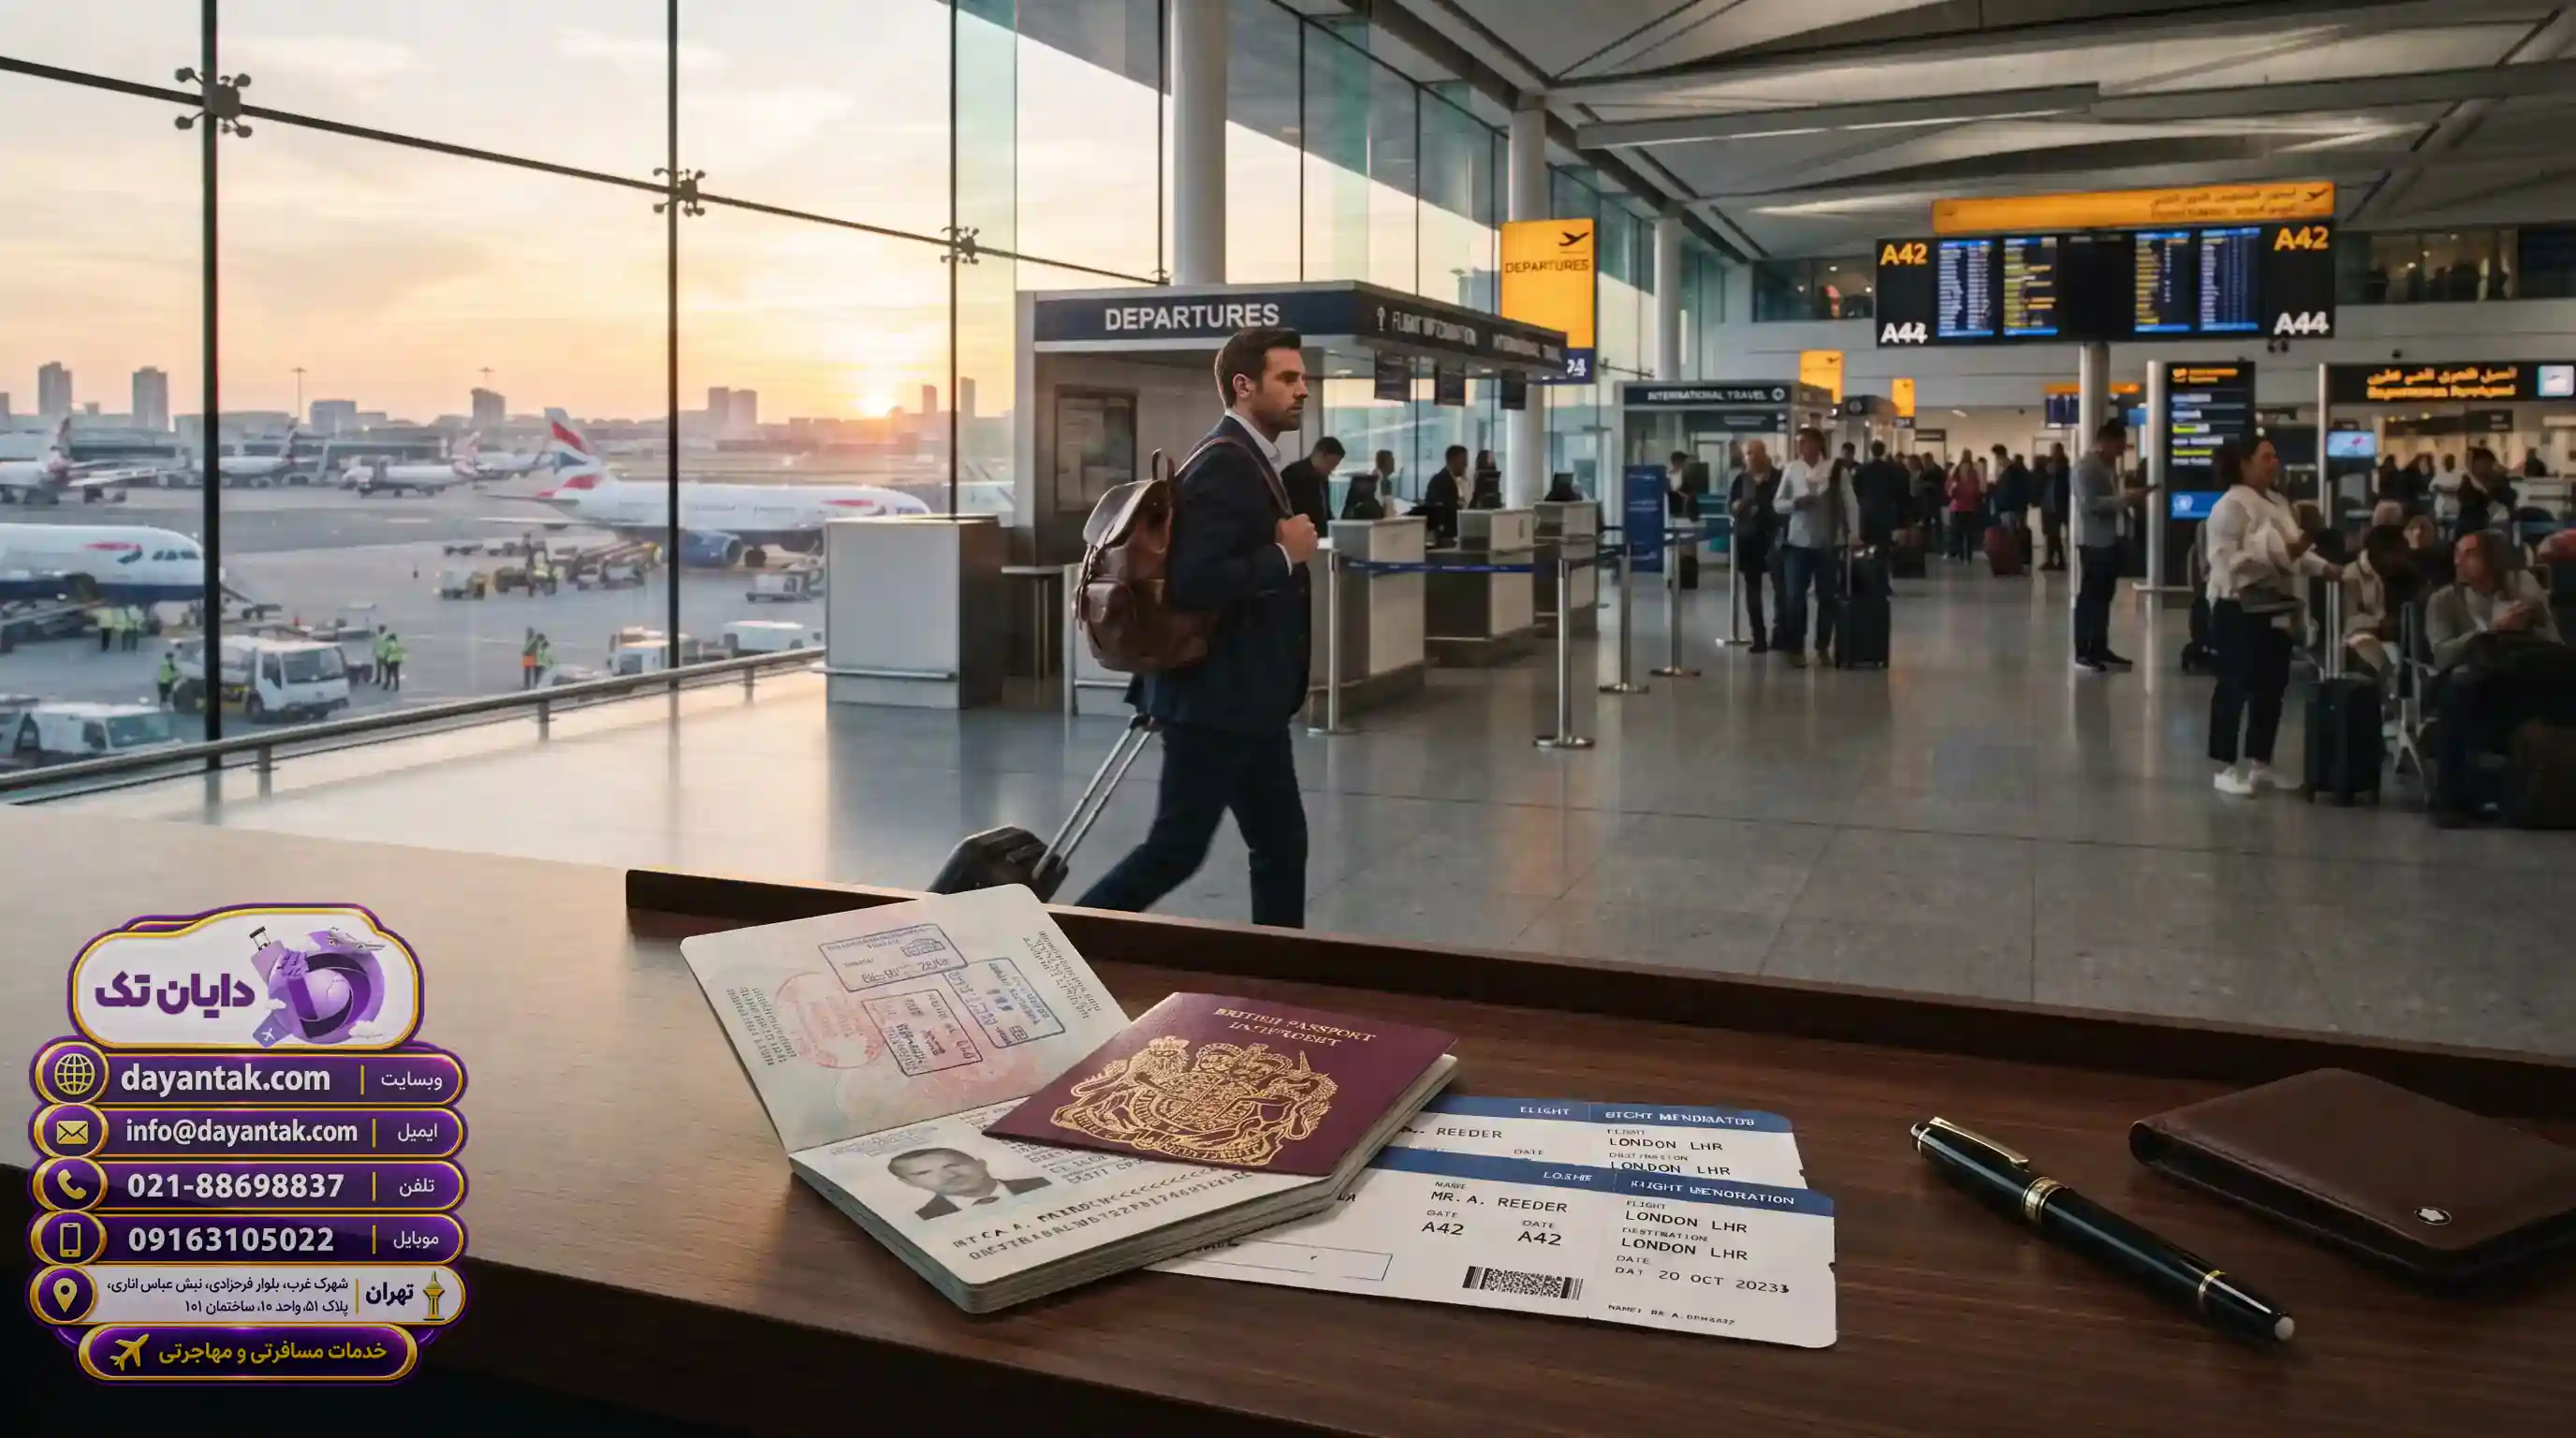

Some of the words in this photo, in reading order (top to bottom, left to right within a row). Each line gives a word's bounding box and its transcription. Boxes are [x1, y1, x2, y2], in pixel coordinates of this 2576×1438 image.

[2274, 226, 2329, 251] A42
[1880, 242, 1928, 266] A42
[1505, 259, 1590, 273] DEPARTURES
[1105, 303, 1280, 330] DEPARTURES
[2274, 311, 2330, 335] A44
[1881, 322, 1928, 344] A44
[1436, 1127, 1502, 1138] REEDER
[1609, 1137, 1676, 1149] LONDON
[1690, 1141, 1723, 1151] LHR
[1611, 1161, 1681, 1173] LONDON
[1697, 1166, 1731, 1176] LHR
[1430, 1191, 1460, 1202] MR.
[1467, 1196, 1485, 1205] A.
[1498, 1197, 1568, 1213] REEDER
[1421, 1221, 1464, 1236] A42
[1522, 1220, 1555, 1229] DATE
[1625, 1211, 1698, 1227] LONDON
[1712, 1221, 1748, 1233] LHR
[1517, 1230, 1562, 1246] A42
[1621, 1238, 1696, 1255] LONDON
[1710, 1248, 1748, 1260] LHR
[1616, 1255, 1650, 1265] DATE
[1659, 1270, 1680, 1281] 20
[1690, 1274, 1724, 1285] OCT
